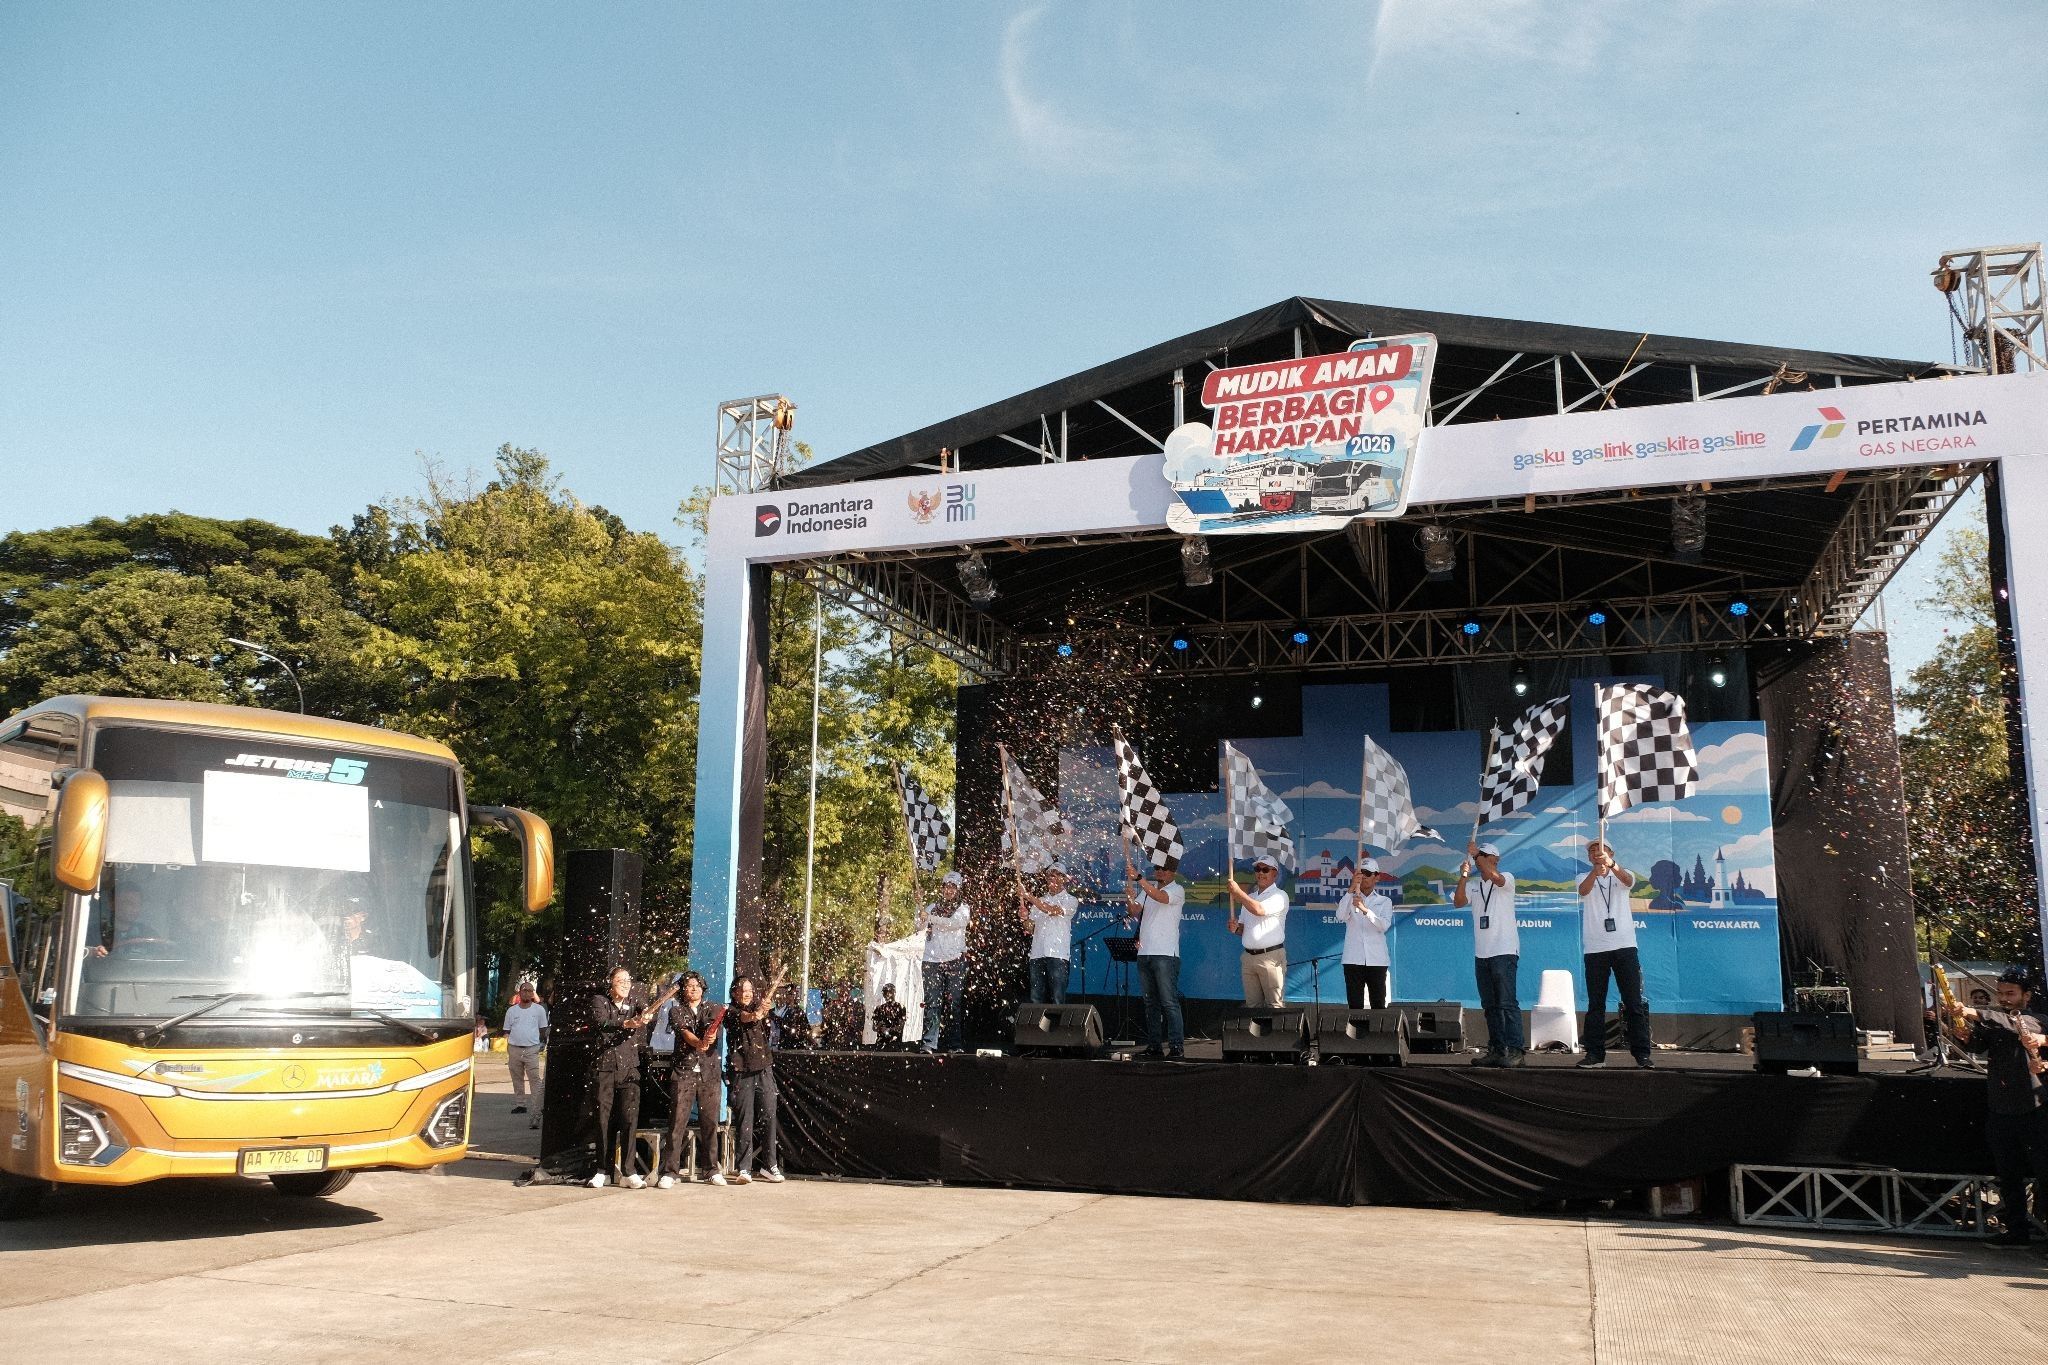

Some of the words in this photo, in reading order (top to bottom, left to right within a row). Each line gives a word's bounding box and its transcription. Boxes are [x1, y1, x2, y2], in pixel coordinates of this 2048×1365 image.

[1216, 364, 1307, 398] MUDIK
[1312, 352, 1399, 385] AMAN
[1217, 387, 1367, 431] BERBAGI
[1857, 410, 1987, 435] PERTAMINA
[1214, 416, 1363, 456] HARAPAN
[1350, 436, 1391, 454] 2026
[1513, 449, 1565, 471] gasku
[1572, 441, 1634, 465] gaslink
[1635, 436, 1700, 459] gaskita
[1702, 430, 1766, 453] gasline
[1859, 441, 1896, 457] GAS
[1901, 435, 1977, 453] NEGARA
[787, 497, 873, 517] Danantara
[786, 516, 867, 535] Indonesia
[1078, 911, 1114, 920] JAKARTA
[1180, 913, 1205, 921] ALAYA
[1415, 918, 1464, 927] WONOGIRI
[1692, 920, 1760, 929] YOGYAKARTA
[247, 1152, 262, 1166] AA
[269, 1150, 299, 1164] 7784
